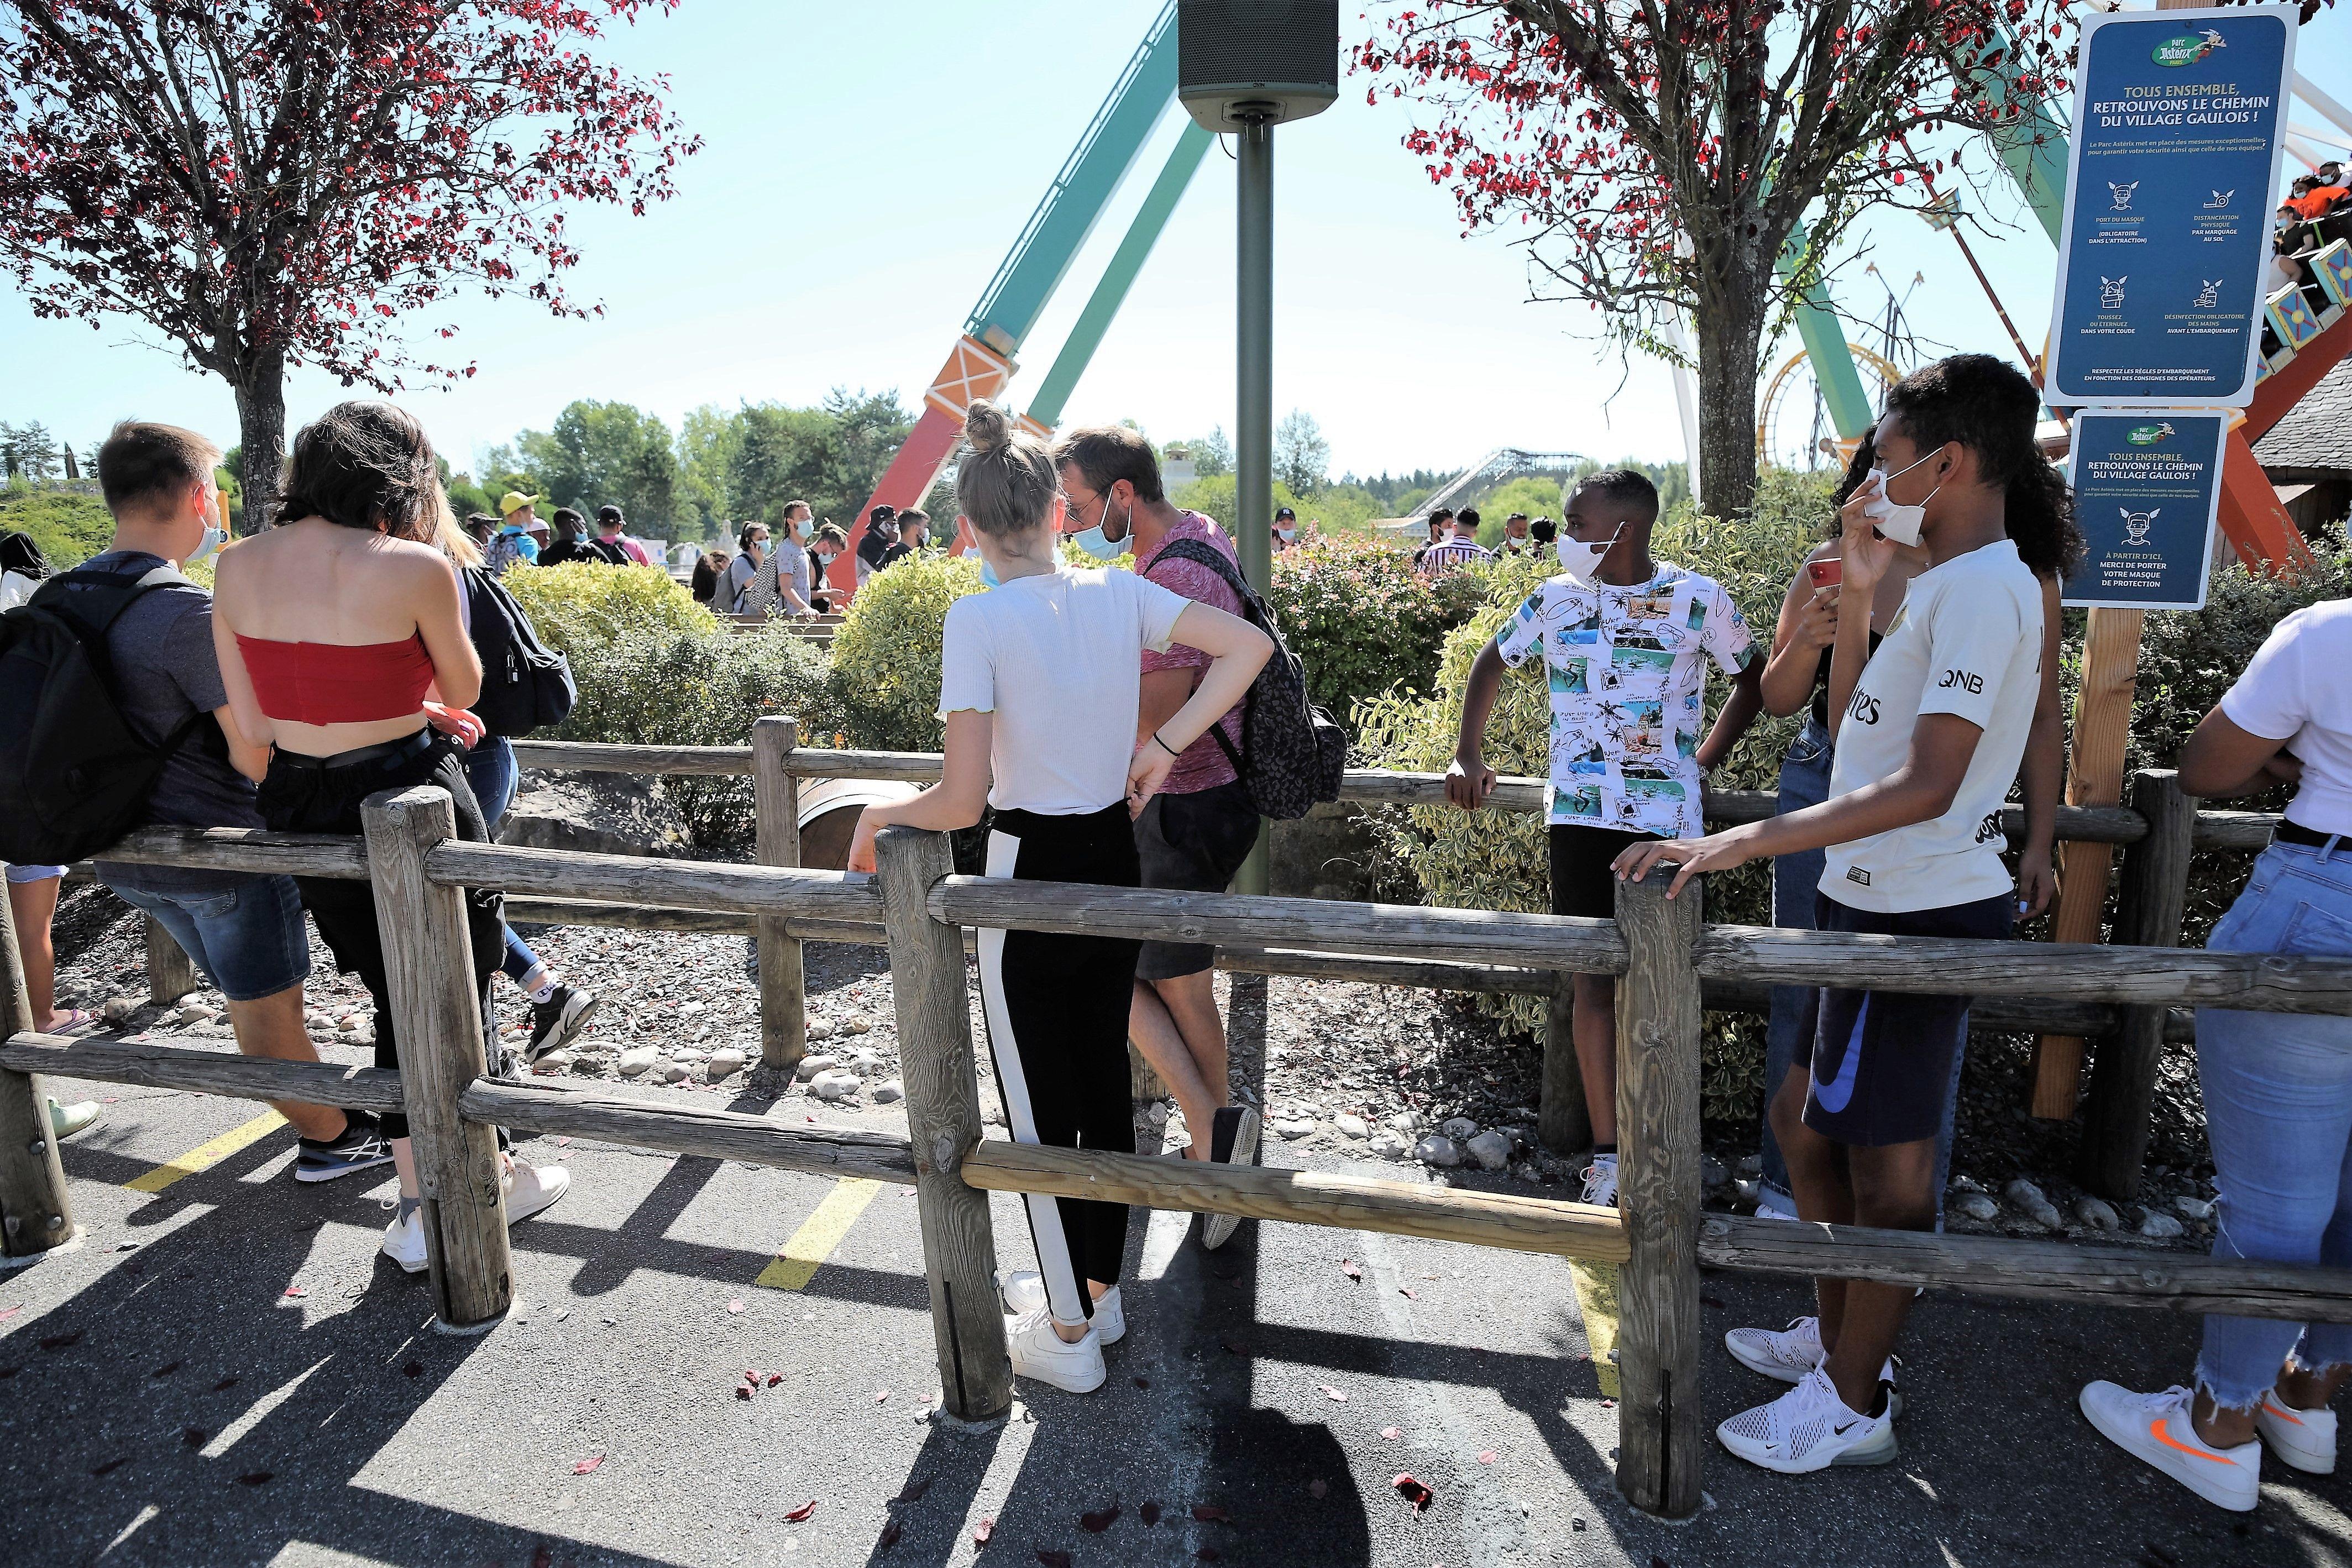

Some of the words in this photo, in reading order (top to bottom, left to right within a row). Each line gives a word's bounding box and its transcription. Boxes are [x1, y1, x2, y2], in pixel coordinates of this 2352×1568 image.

[2124, 86, 2161, 98] TOUS
[2166, 83, 2240, 97] ENSEMBLE,
[2094, 99, 2188, 113] RETROUVONS
[2192, 98, 2208, 110] LE
[2211, 96, 2270, 109] CHEMIN
[2101, 116, 2122, 127] DU
[2126, 113, 2182, 126] VILLAGE
[2187, 111, 2249, 124] GAULOIS
[2253, 111, 2258, 122] !
[2109, 453, 2133, 461] TOUS
[2136, 454, 2184, 462] ENSEMBLE,
[2166, 463, 2203, 471] CHEMIN
[2109, 471, 2146, 479] VILLAGE
[1938, 669, 1984, 695] QNB
[1623, 753, 1643, 762] DEEP
